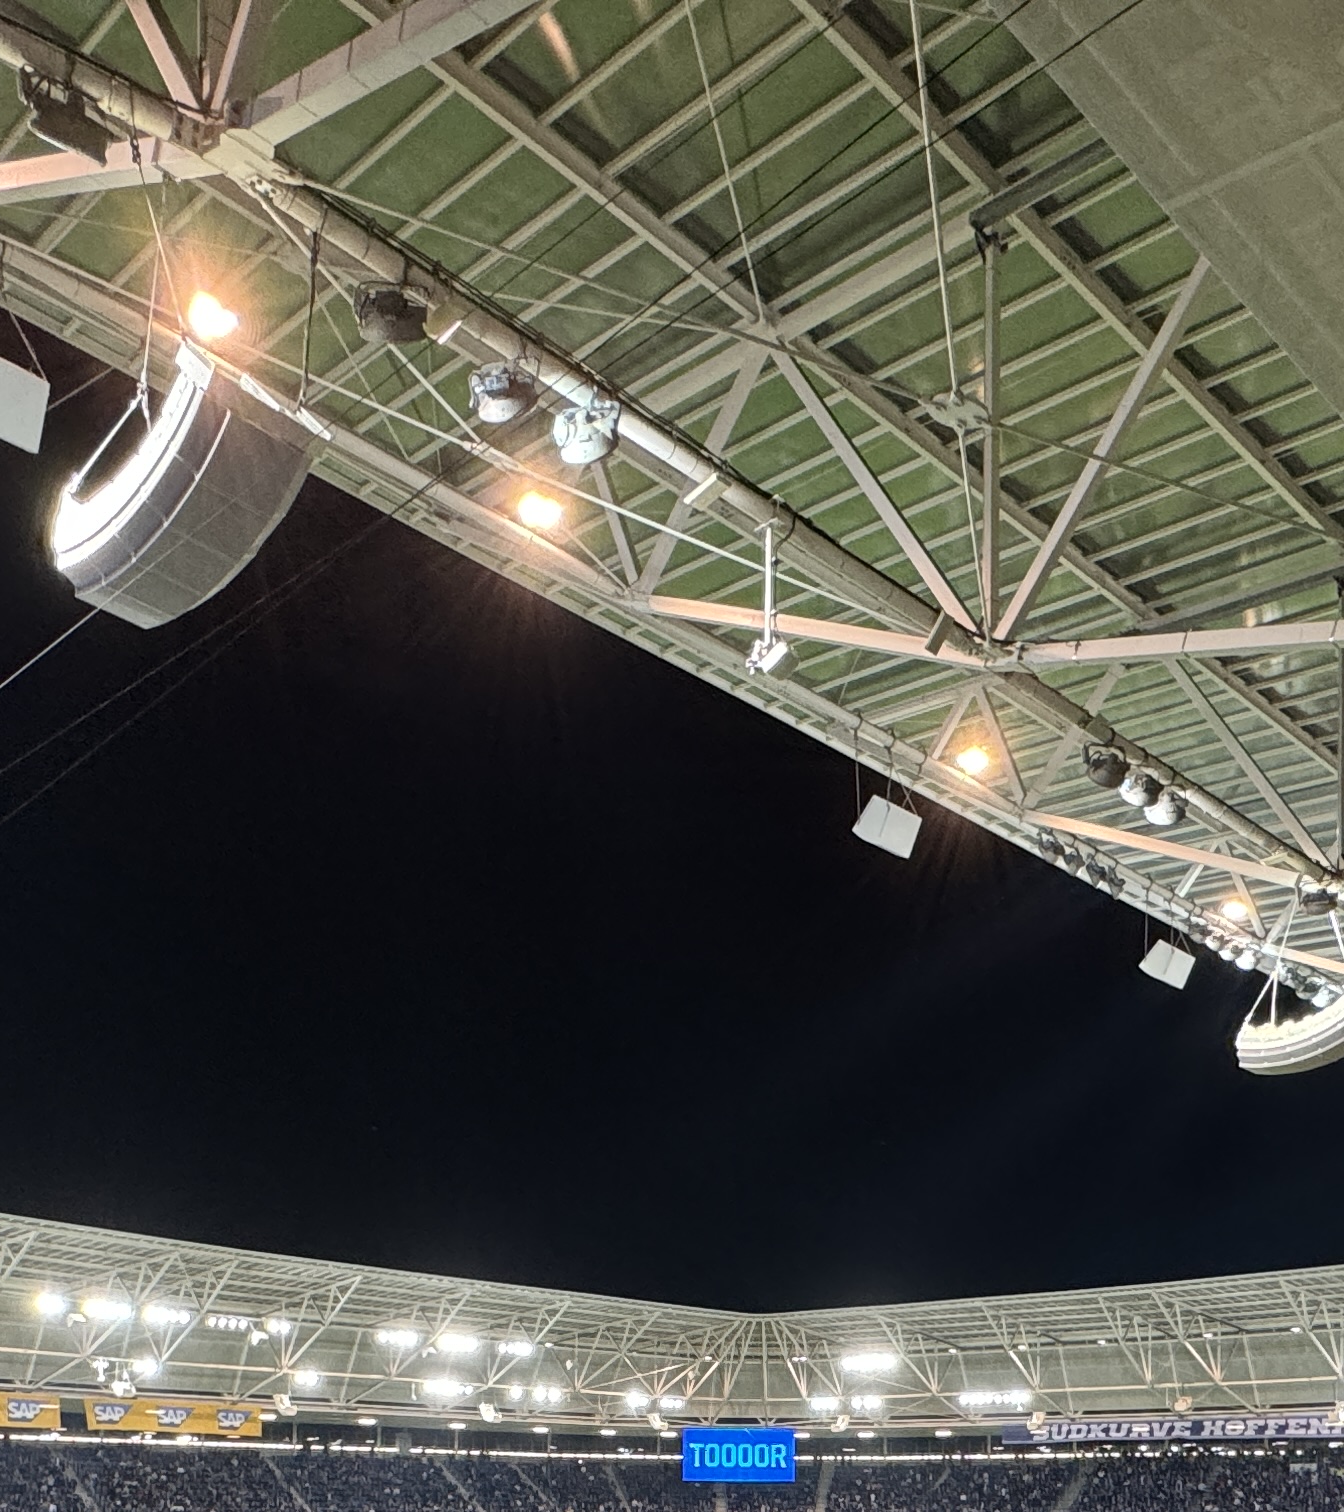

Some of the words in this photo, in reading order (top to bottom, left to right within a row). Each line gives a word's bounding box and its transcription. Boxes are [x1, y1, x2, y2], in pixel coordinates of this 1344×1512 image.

[8, 1401, 41, 1419] SAP
[94, 1406, 125, 1422] SAP
[157, 1409, 187, 1425] SAP
[217, 1412, 245, 1427] SAP
[689, 1443, 787, 1468] TOOOOR
